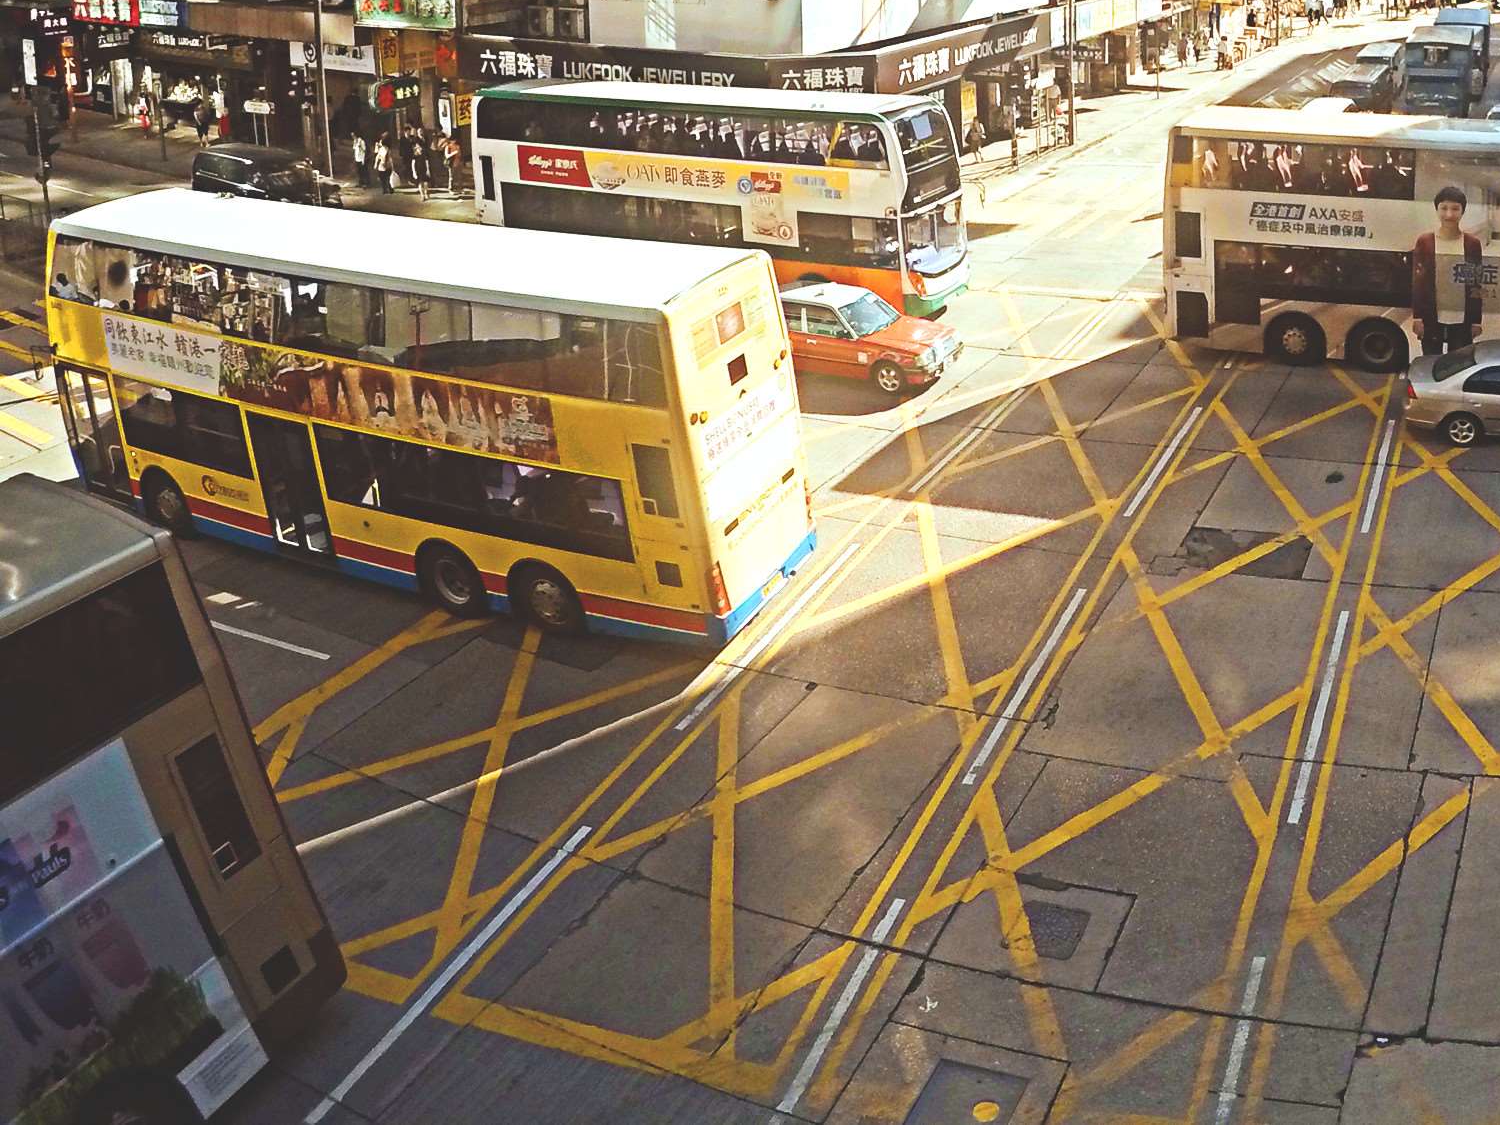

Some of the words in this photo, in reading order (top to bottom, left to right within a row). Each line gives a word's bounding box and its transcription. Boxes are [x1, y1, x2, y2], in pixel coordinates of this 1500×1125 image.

[898, 47, 950, 86] 六福珠寶
[954, 37, 994, 65] LUKFOOK
[995, 26, 1039, 55] JEWELLERY
[480, 49, 553, 79] 六福珠寶
[563, 60, 633, 83] LUKFOOK
[638, 67, 736, 89] JEWELLERY
[782, 65, 864, 90] 六福珠寶
[665, 166, 726, 188] 即食燕麥
[1252, 203, 1303, 219] 全港首創
